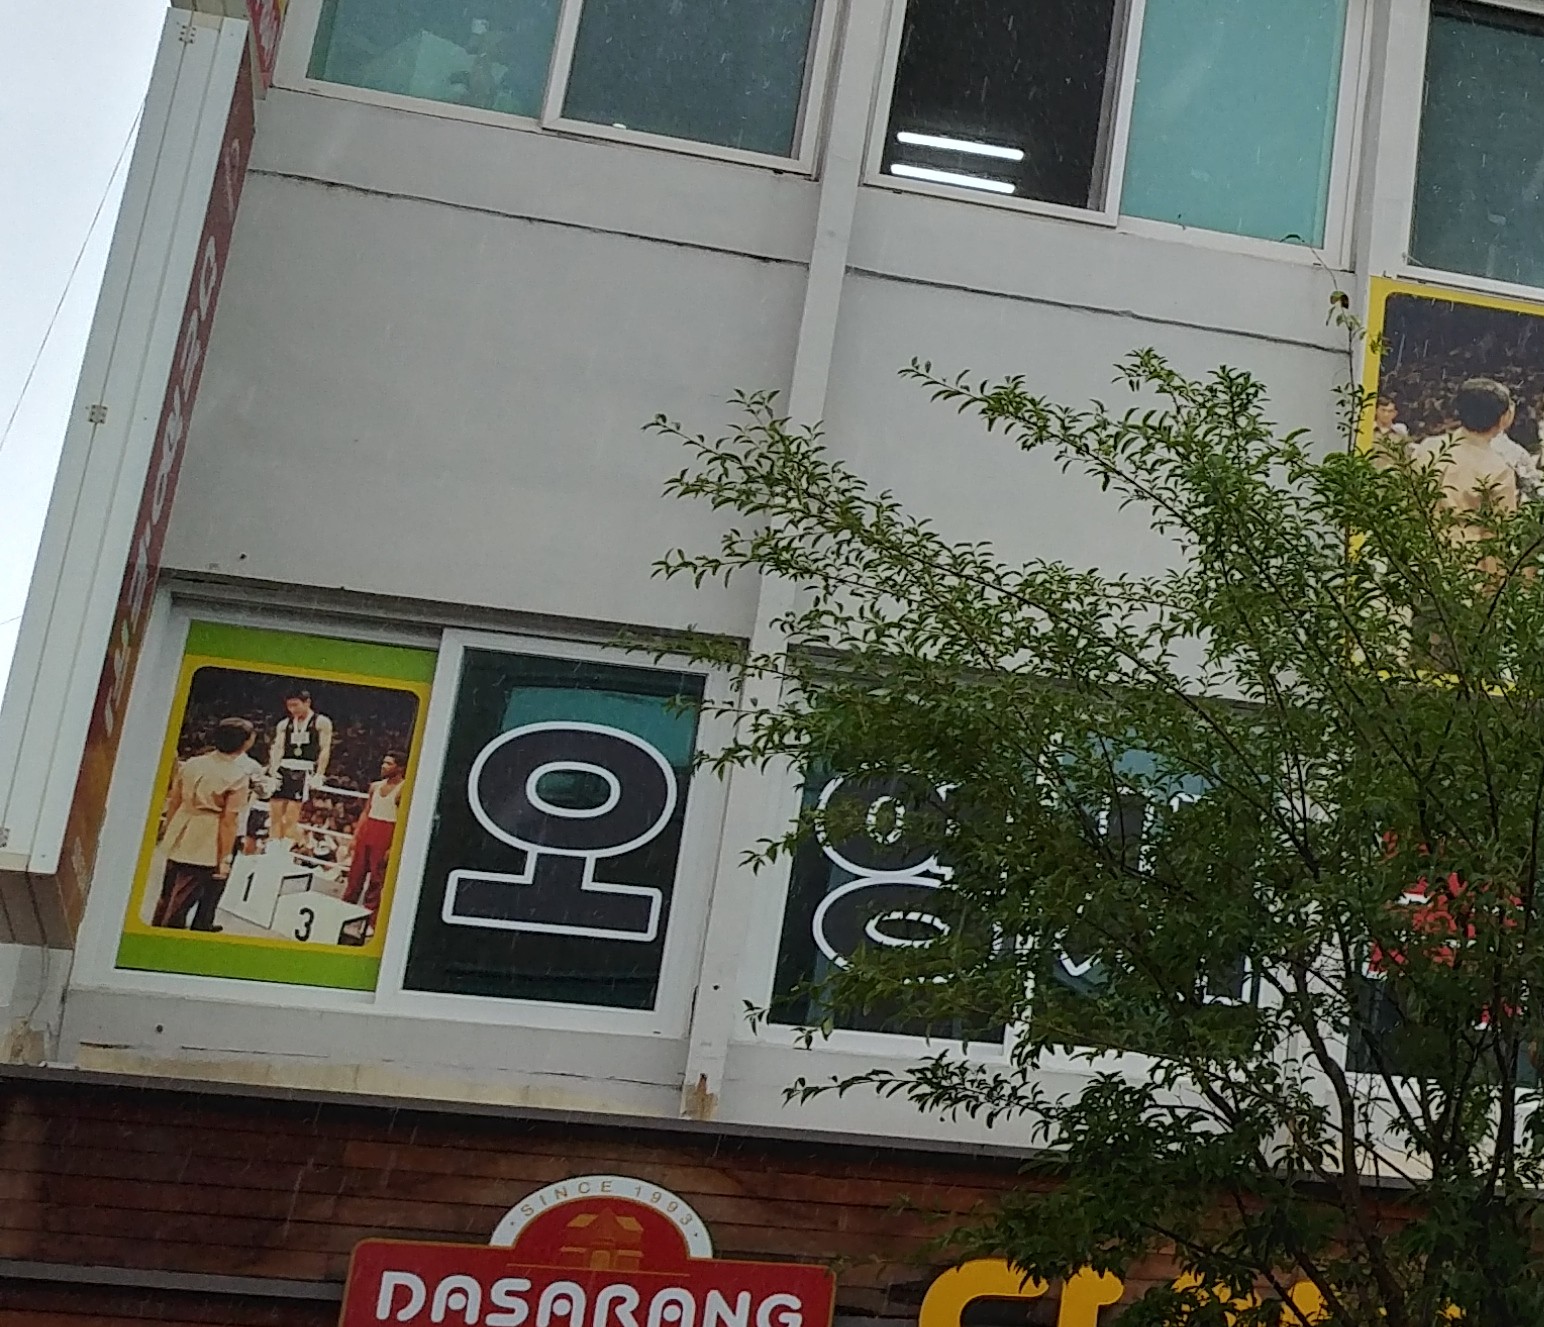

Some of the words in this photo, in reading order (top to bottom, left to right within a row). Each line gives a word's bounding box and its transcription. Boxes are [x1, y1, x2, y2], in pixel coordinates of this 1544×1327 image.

[294, 907, 315, 942] 3
[520, 1180, 614, 1218] SINCE
[634, 1185, 693, 1226] 1993
[375, 1270, 804, 1327] DASARANG
